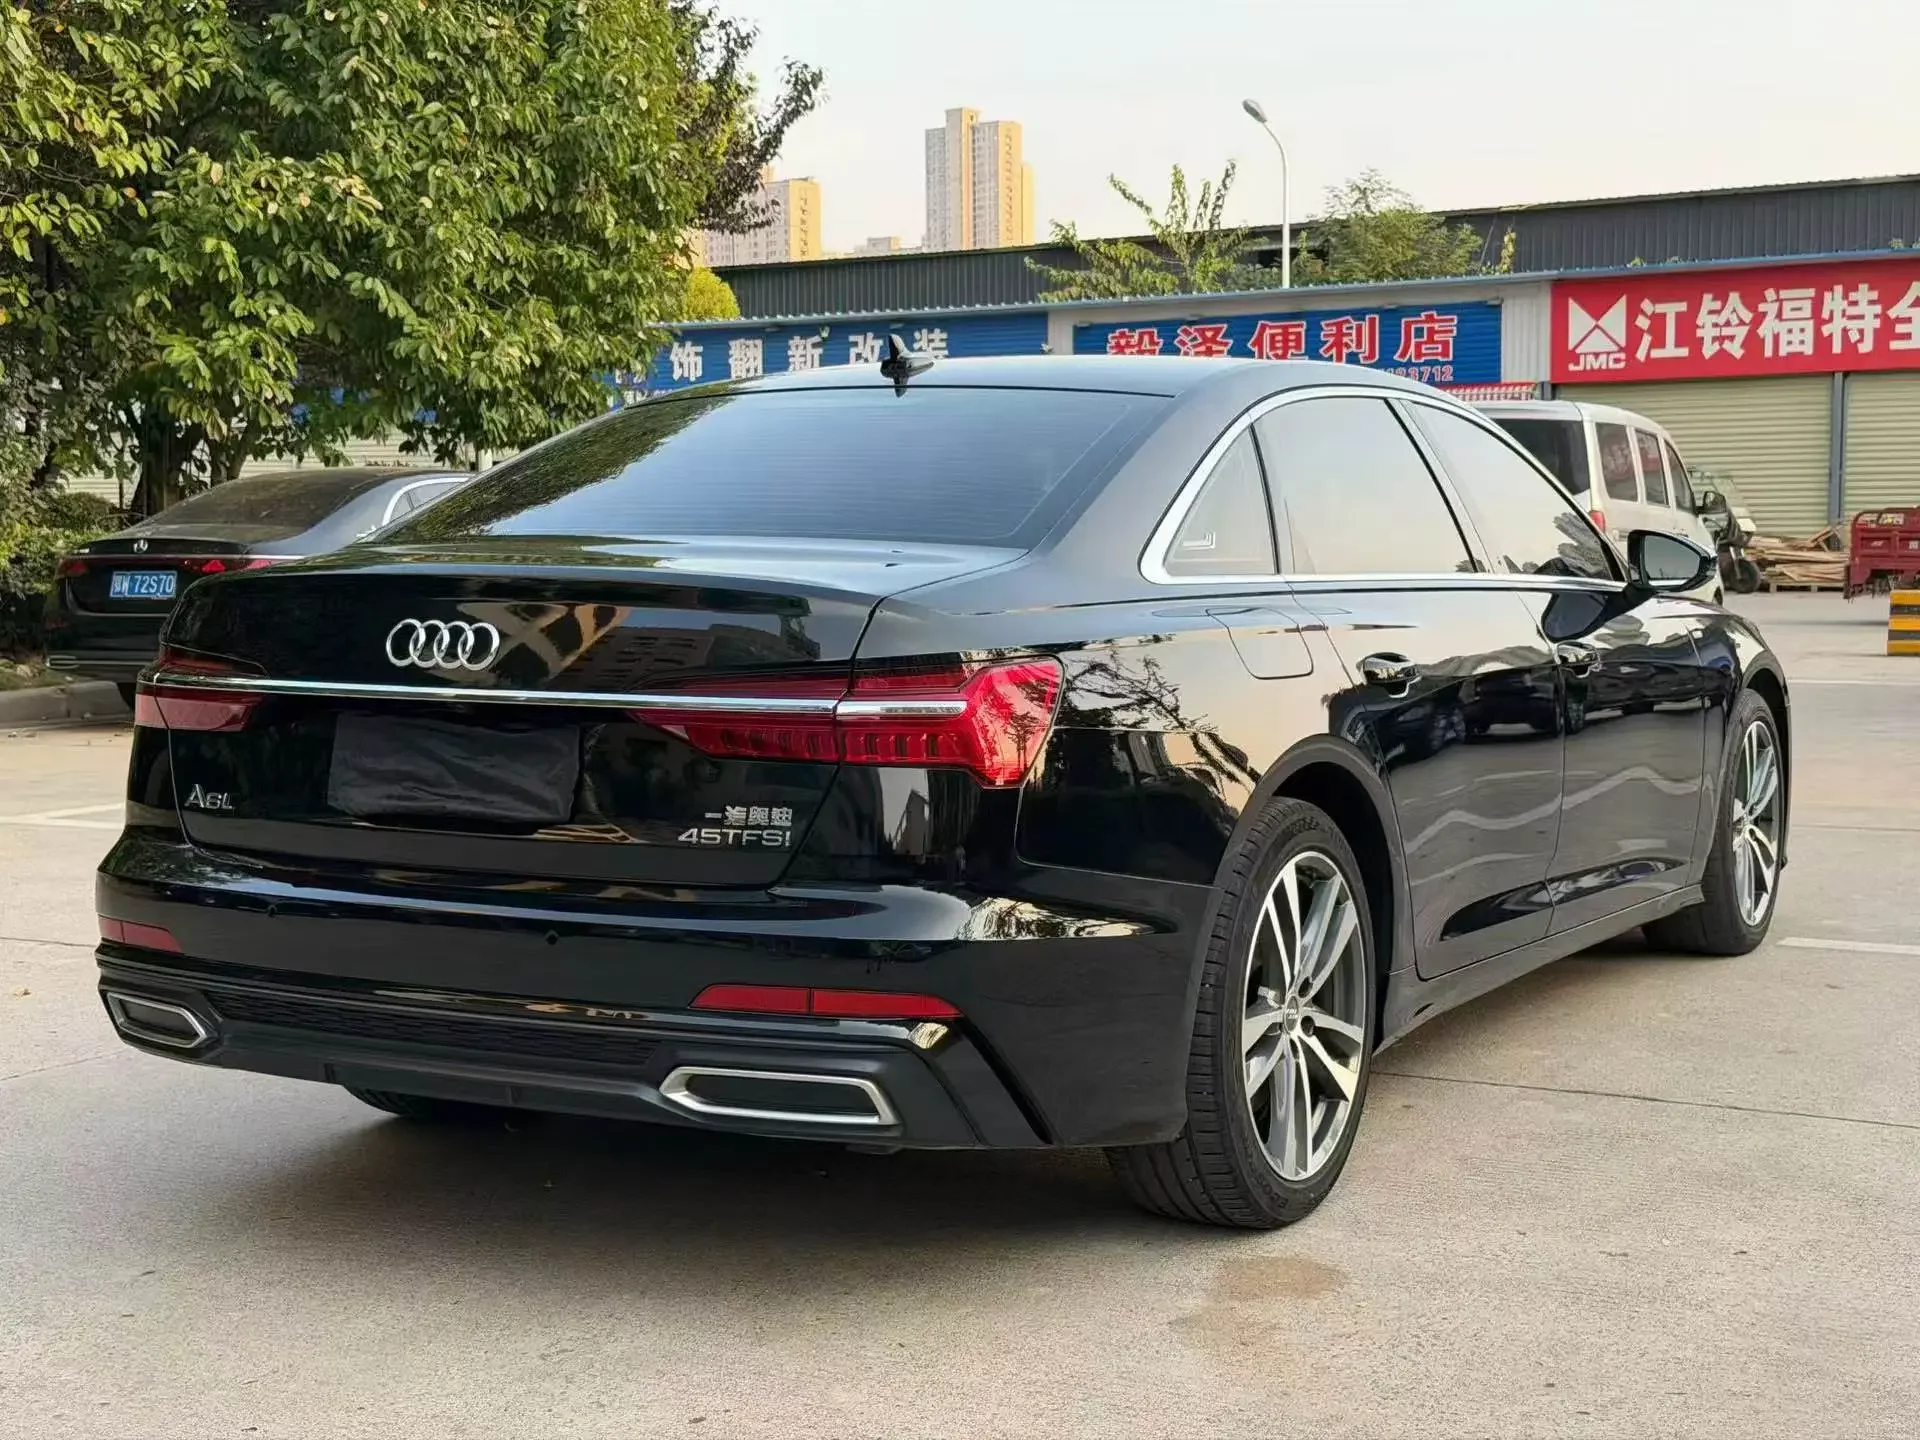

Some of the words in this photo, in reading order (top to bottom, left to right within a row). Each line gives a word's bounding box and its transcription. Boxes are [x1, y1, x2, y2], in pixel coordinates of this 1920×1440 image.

[1634, 280, 1919, 363] 江铃福特全
[614, 328, 950, 386] 饰翻新改装
[1568, 352, 1626, 371] JMC
[184, 783, 233, 809] A6L
